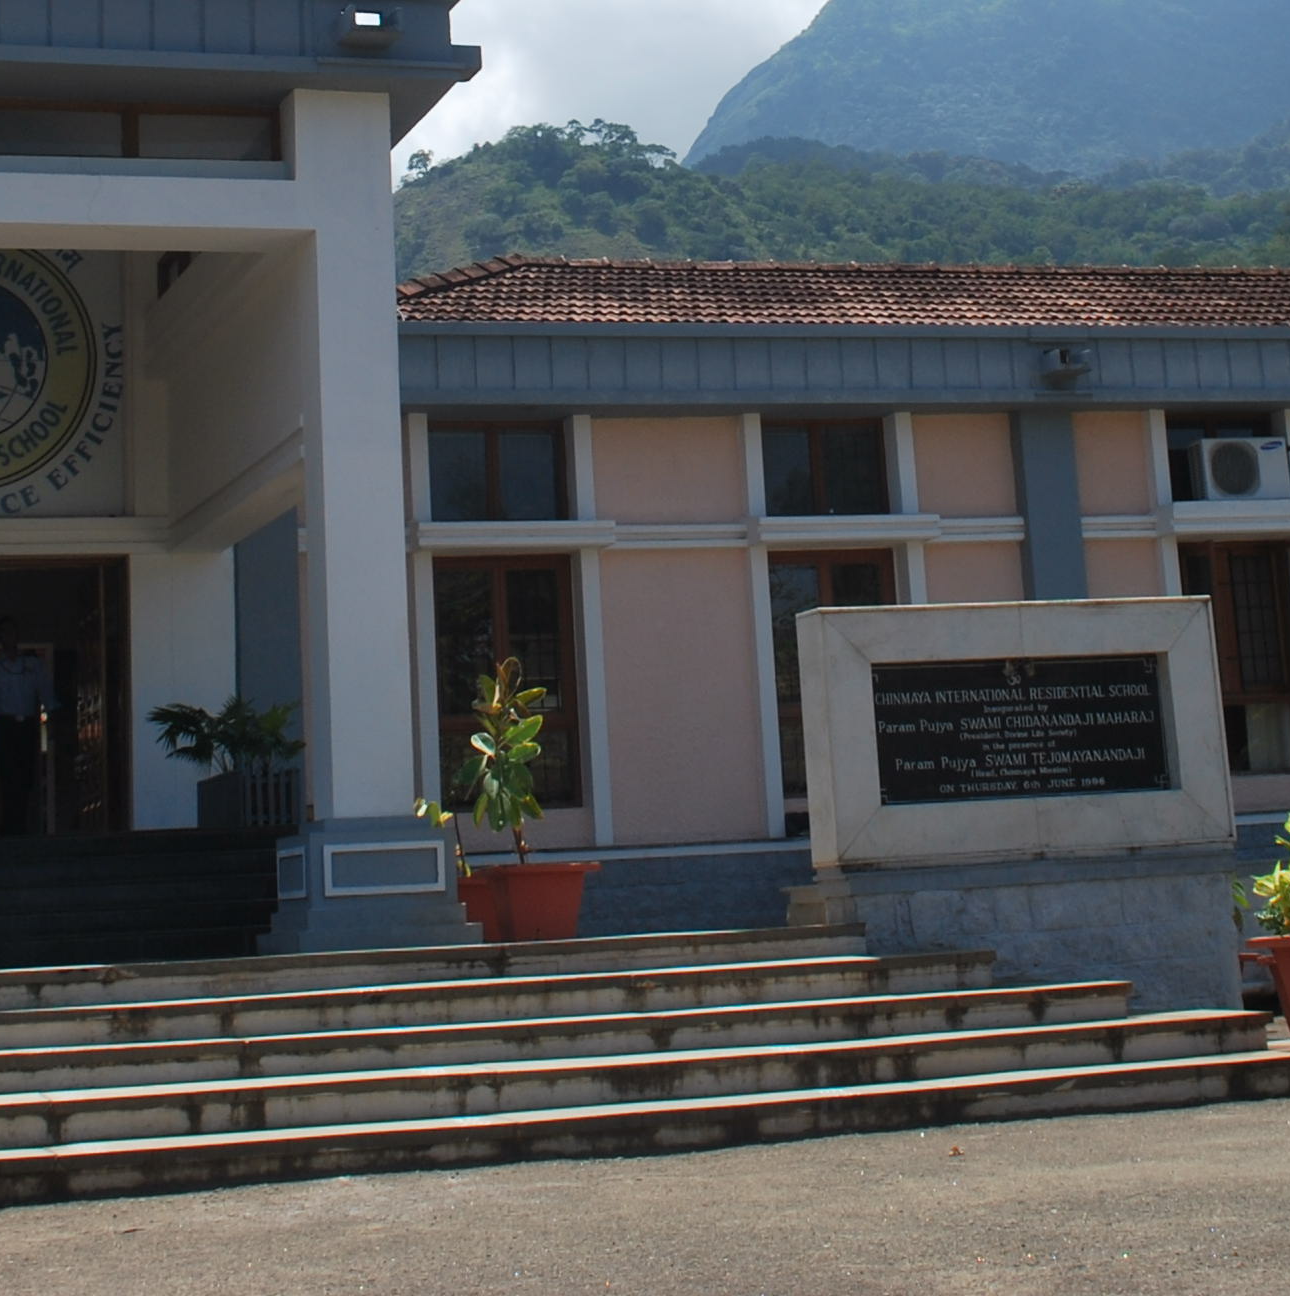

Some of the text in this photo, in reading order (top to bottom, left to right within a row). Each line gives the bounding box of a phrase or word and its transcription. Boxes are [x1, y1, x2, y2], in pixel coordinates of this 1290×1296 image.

[44, 321, 125, 492] EFFICIENCY
[875, 683, 1151, 706] CHINMAYA INTERNATIONAL RESIDENTIAL SCHOOL
[1037, 703, 1049, 713] by
[878, 710, 1155, 734] Param Pujya SWAMI CHIDANANDAJI MAHARAJ
[992, 741, 1006, 750] the
[895, 747, 1146, 773] Param Pujya SWAMI TEJOMAYANANDAJI
[939, 783, 955, 794] ON
[1023, 779, 1041, 790] 6th
[1047, 778, 1076, 789] JUNE
[1080, 776, 1106, 787] 1996
